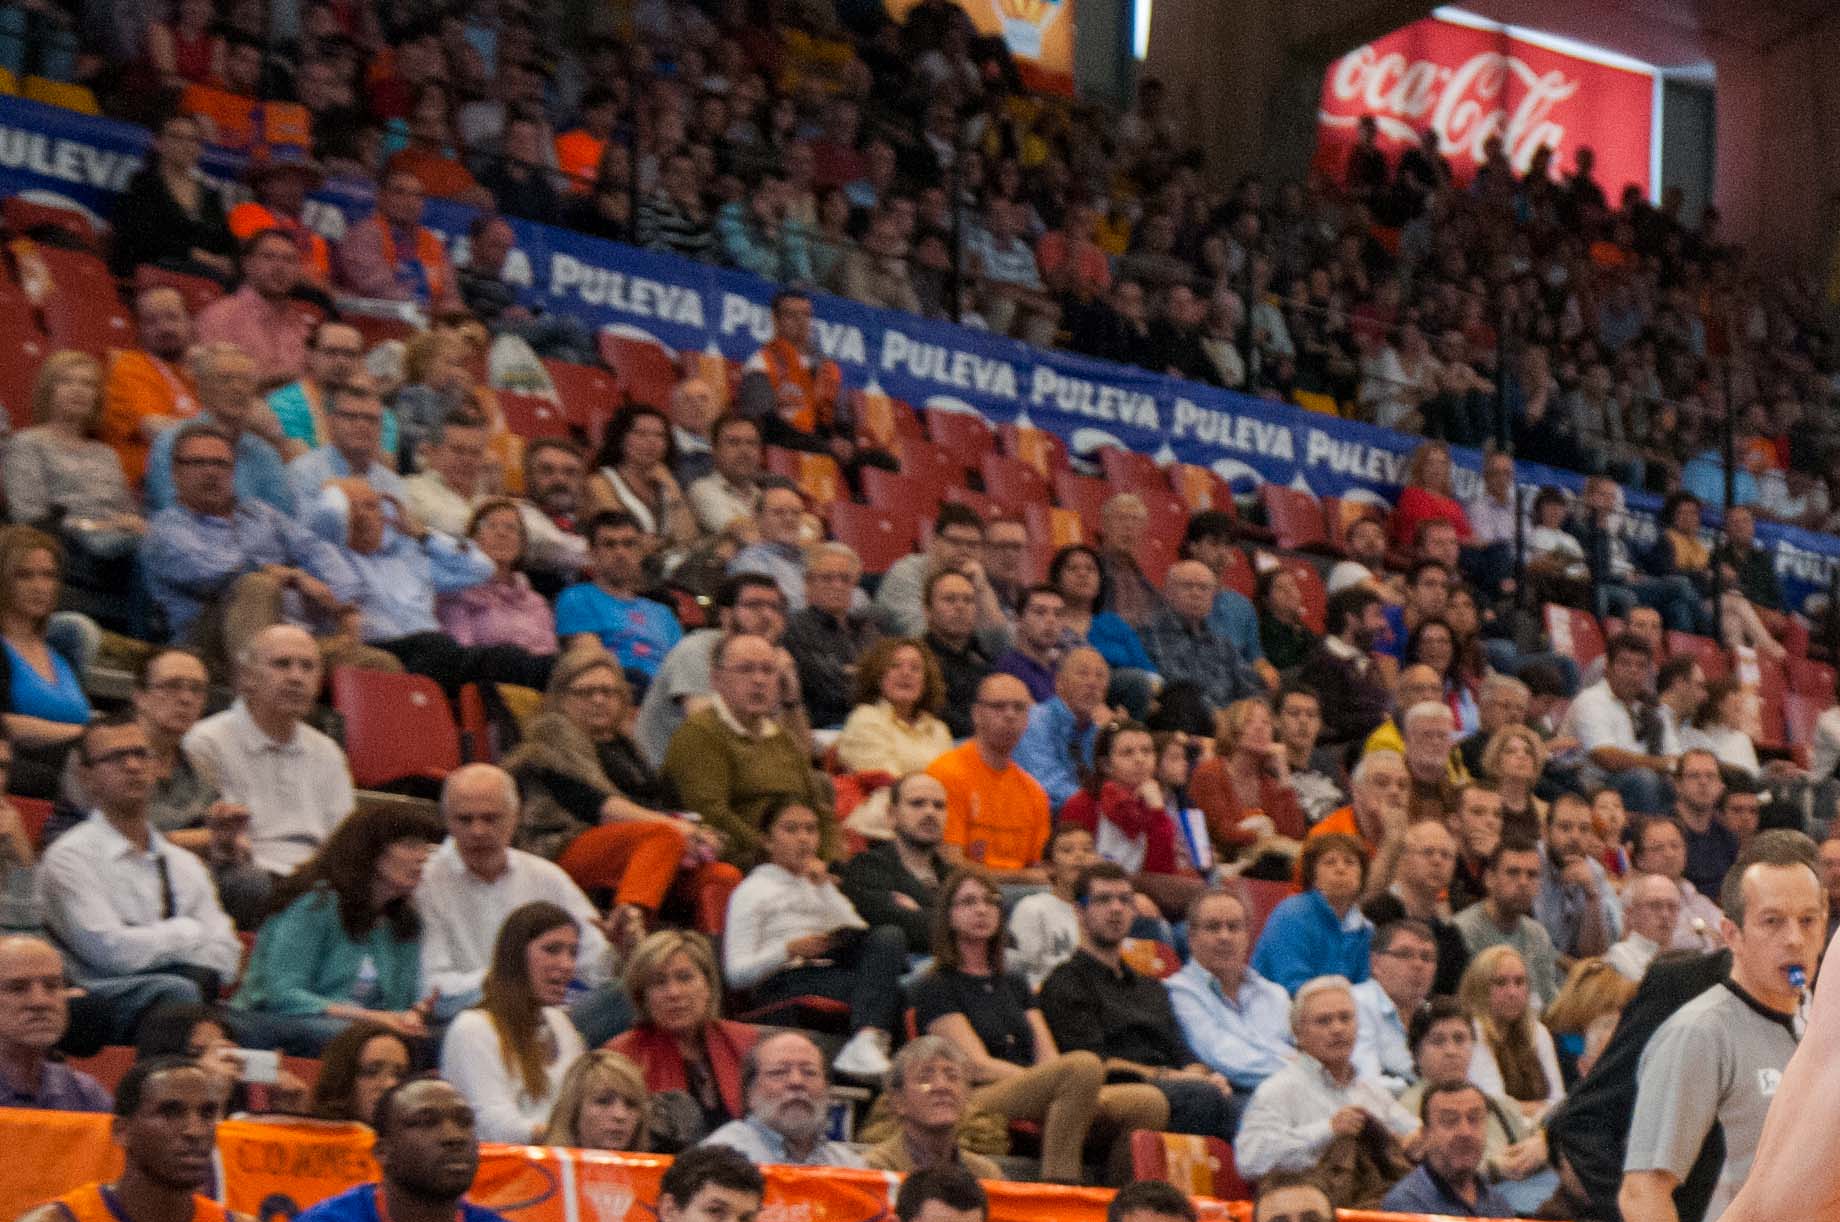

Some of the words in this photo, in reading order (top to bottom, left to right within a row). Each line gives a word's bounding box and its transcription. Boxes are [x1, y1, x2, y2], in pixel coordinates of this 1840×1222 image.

[0, 126, 146, 194] ULEV
[550, 252, 704, 329] PULEVA
[723, 292, 866, 364] PUVA
[881, 330, 1017, 398] PULEVA
[1032, 367, 1160, 430] PULEVA
[1173, 398, 1295, 461] PULEVA
[1306, 427, 1404, 484] PULEV
